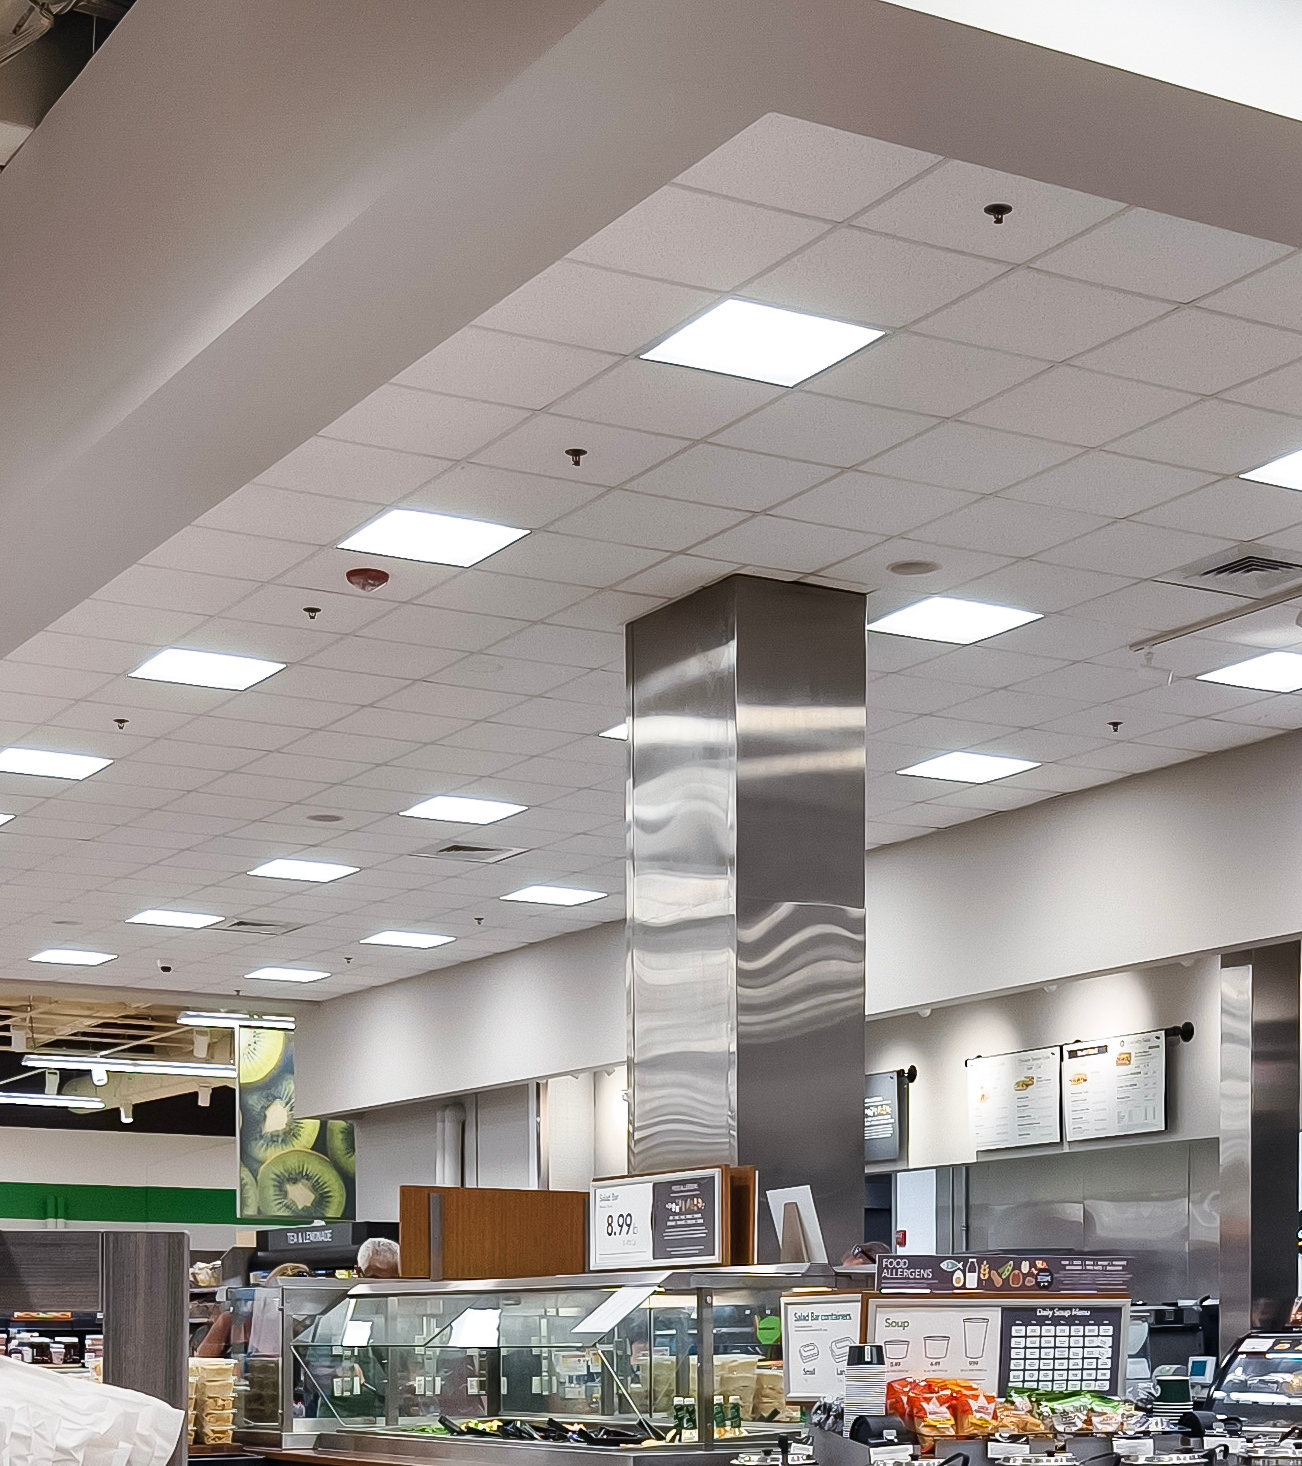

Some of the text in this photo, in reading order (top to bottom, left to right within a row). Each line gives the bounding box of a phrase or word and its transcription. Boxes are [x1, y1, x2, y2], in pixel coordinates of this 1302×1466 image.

[606, 1212, 633, 1237] 8.99
[882, 1258, 909, 1269] FOOD
[881, 1268, 933, 1279] ALLERGENS
[794, 1311, 852, 1323] Salad Bar containers
[1036, 1308, 1090, 1318] Daily Soup Menu
[884, 1317, 910, 1331] Soup
